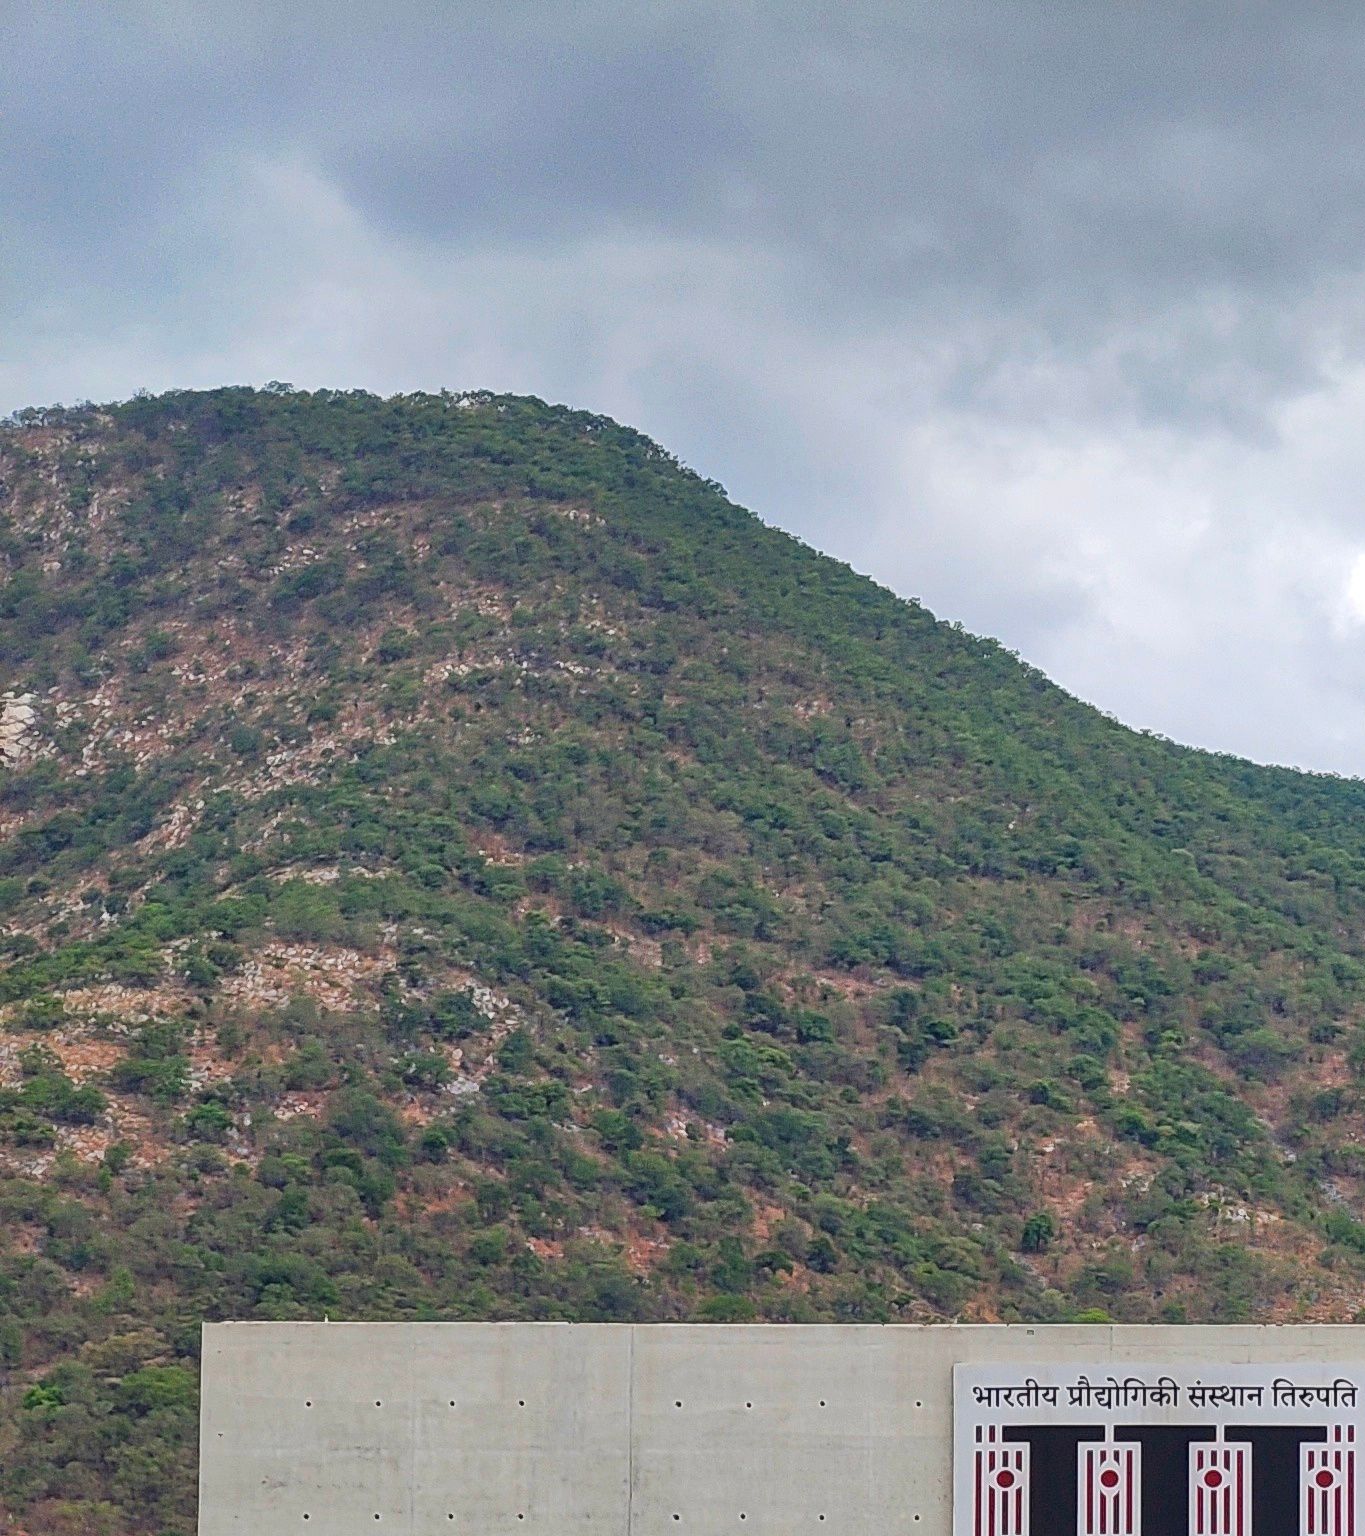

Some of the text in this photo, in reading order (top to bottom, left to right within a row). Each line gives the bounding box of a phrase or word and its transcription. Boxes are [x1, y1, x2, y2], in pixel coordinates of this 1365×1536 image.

[973, 1376, 1358, 1409] भारतीय प्रौद्योगिकी संस्थान तिरुपति
